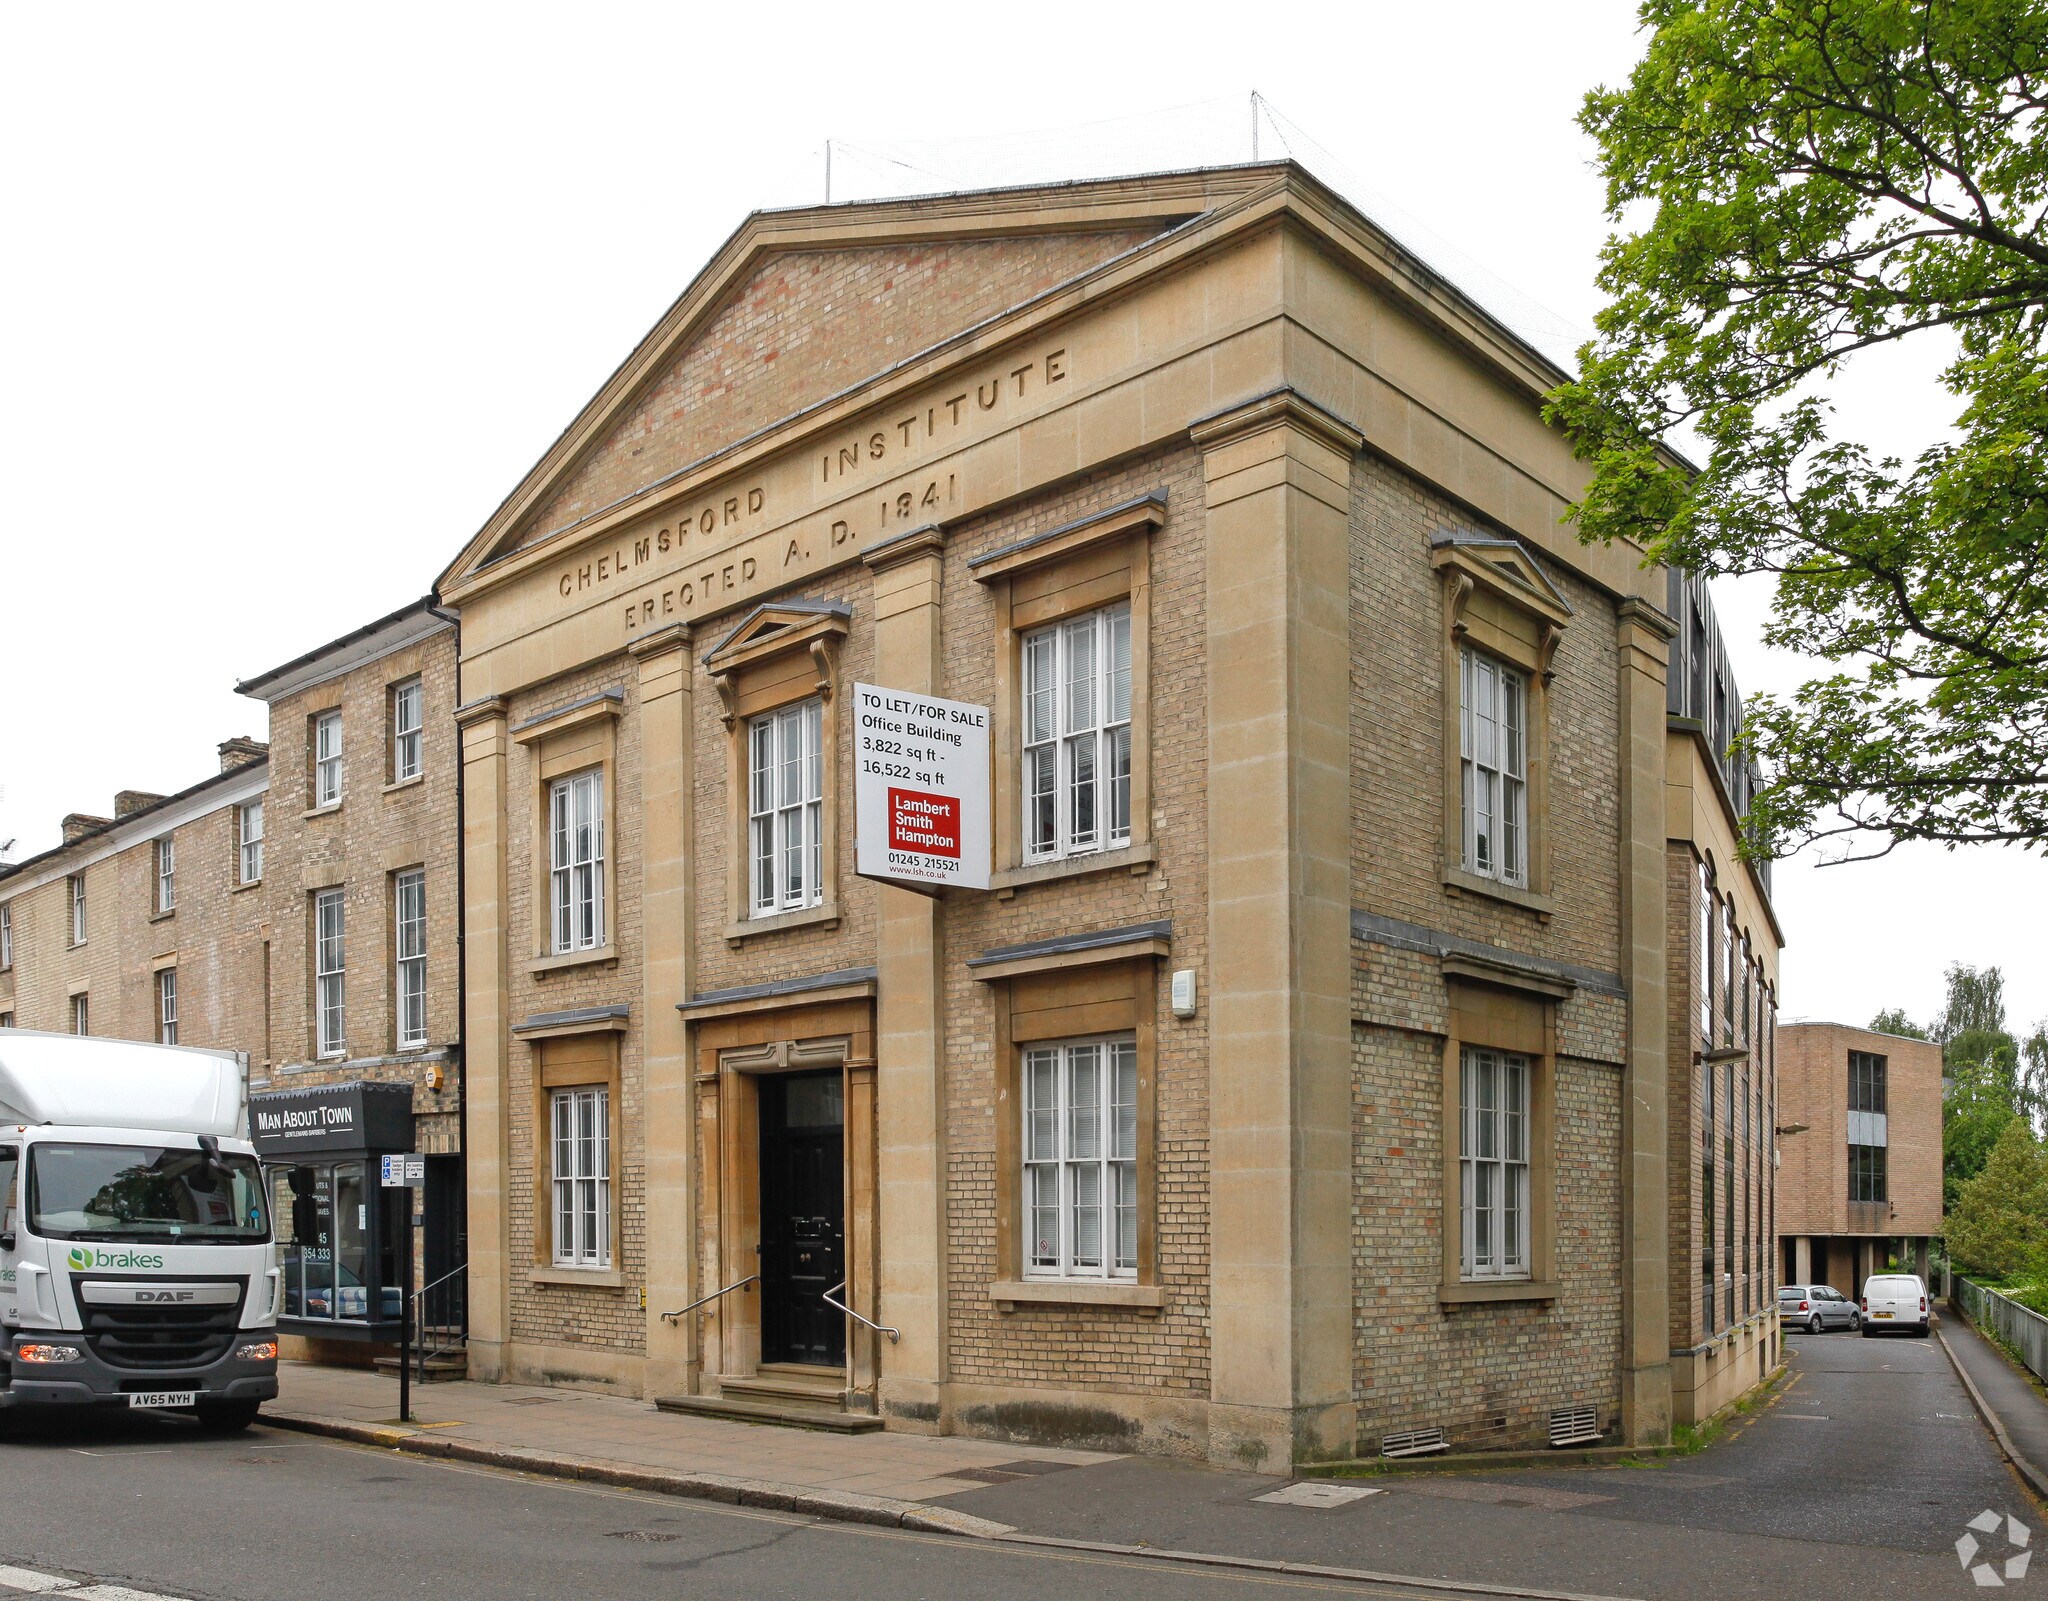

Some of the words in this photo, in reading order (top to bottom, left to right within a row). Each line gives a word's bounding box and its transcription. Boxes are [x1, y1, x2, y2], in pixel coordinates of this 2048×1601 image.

[559, 487, 765, 598] CHELMSFORD
[822, 349, 1066, 483] INSTITUTE
[625, 557, 757, 630] ERECTED
[880, 473, 956, 528] 1841
[862, 693, 881, 708] TO
[886, 698, 946, 721] LET/FOR
[951, 710, 984, 728] SALE
[862, 714, 902, 733] Office
[907, 722, 962, 747] Building
[863, 737, 902, 755] 3,822
[906, 747, 922, 762] sq
[926, 748, 936, 761] ft
[863, 760, 911, 779] 16,522
[915, 771, 931, 786] sq
[935, 772, 945, 785] ft
[895, 795, 950, 817] Lambert
[895, 811, 933, 830] Smith
[896, 826, 954, 848] Hampton
[888, 852, 920, 867] 01245
[924, 857, 959, 872] 215521
[889, 866, 947, 879] www.lsh.co.uk
[95, 1248, 164, 1269] brakes
[0, 1265, 16, 1281] rakes
[135, 1291, 194, 1302] DAF
[134, 1394, 165, 1405] AV65
[168, 1393, 190, 1404] NYH
